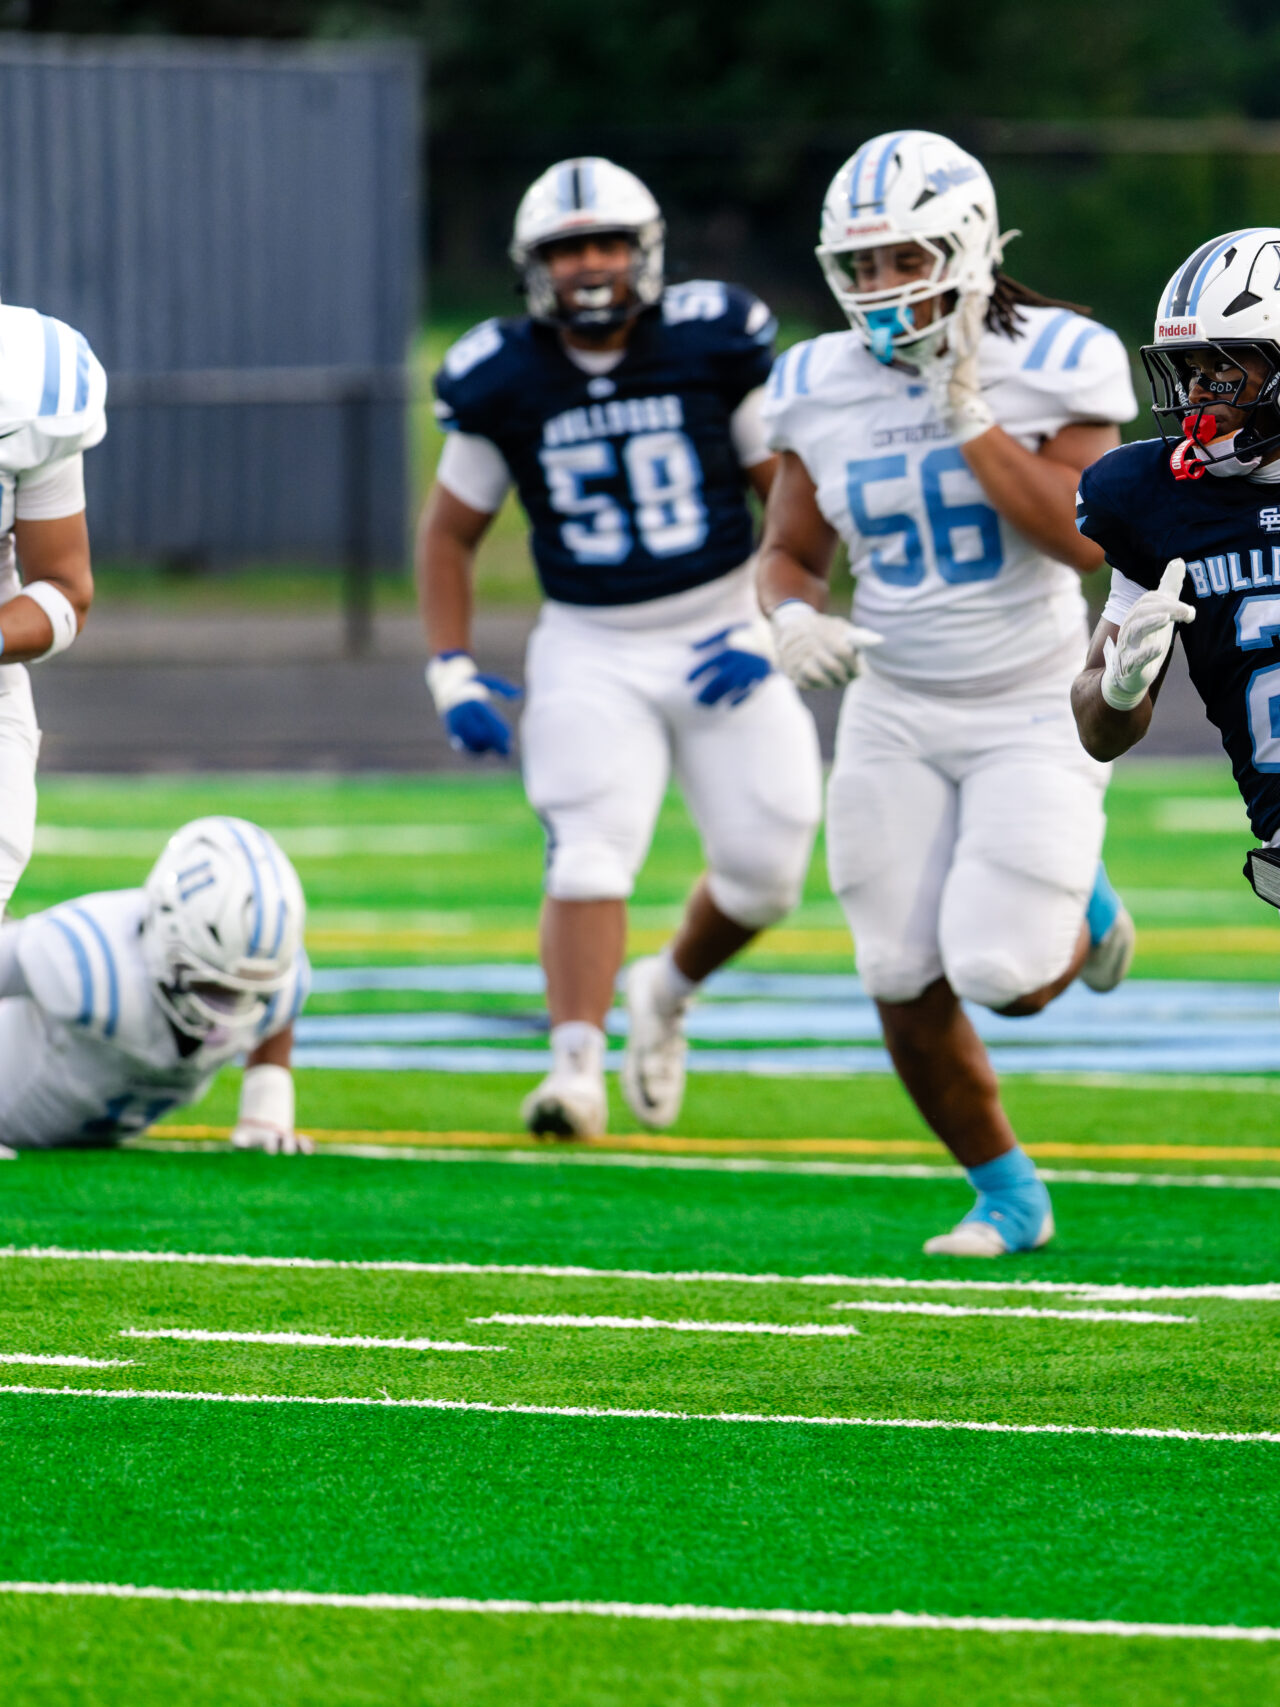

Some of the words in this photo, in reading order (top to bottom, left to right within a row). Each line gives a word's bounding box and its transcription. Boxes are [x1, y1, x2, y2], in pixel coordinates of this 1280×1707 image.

[1158, 323, 1197, 338] Riddell
[538, 430, 709, 566] 58
[846, 445, 1004, 588] 56
